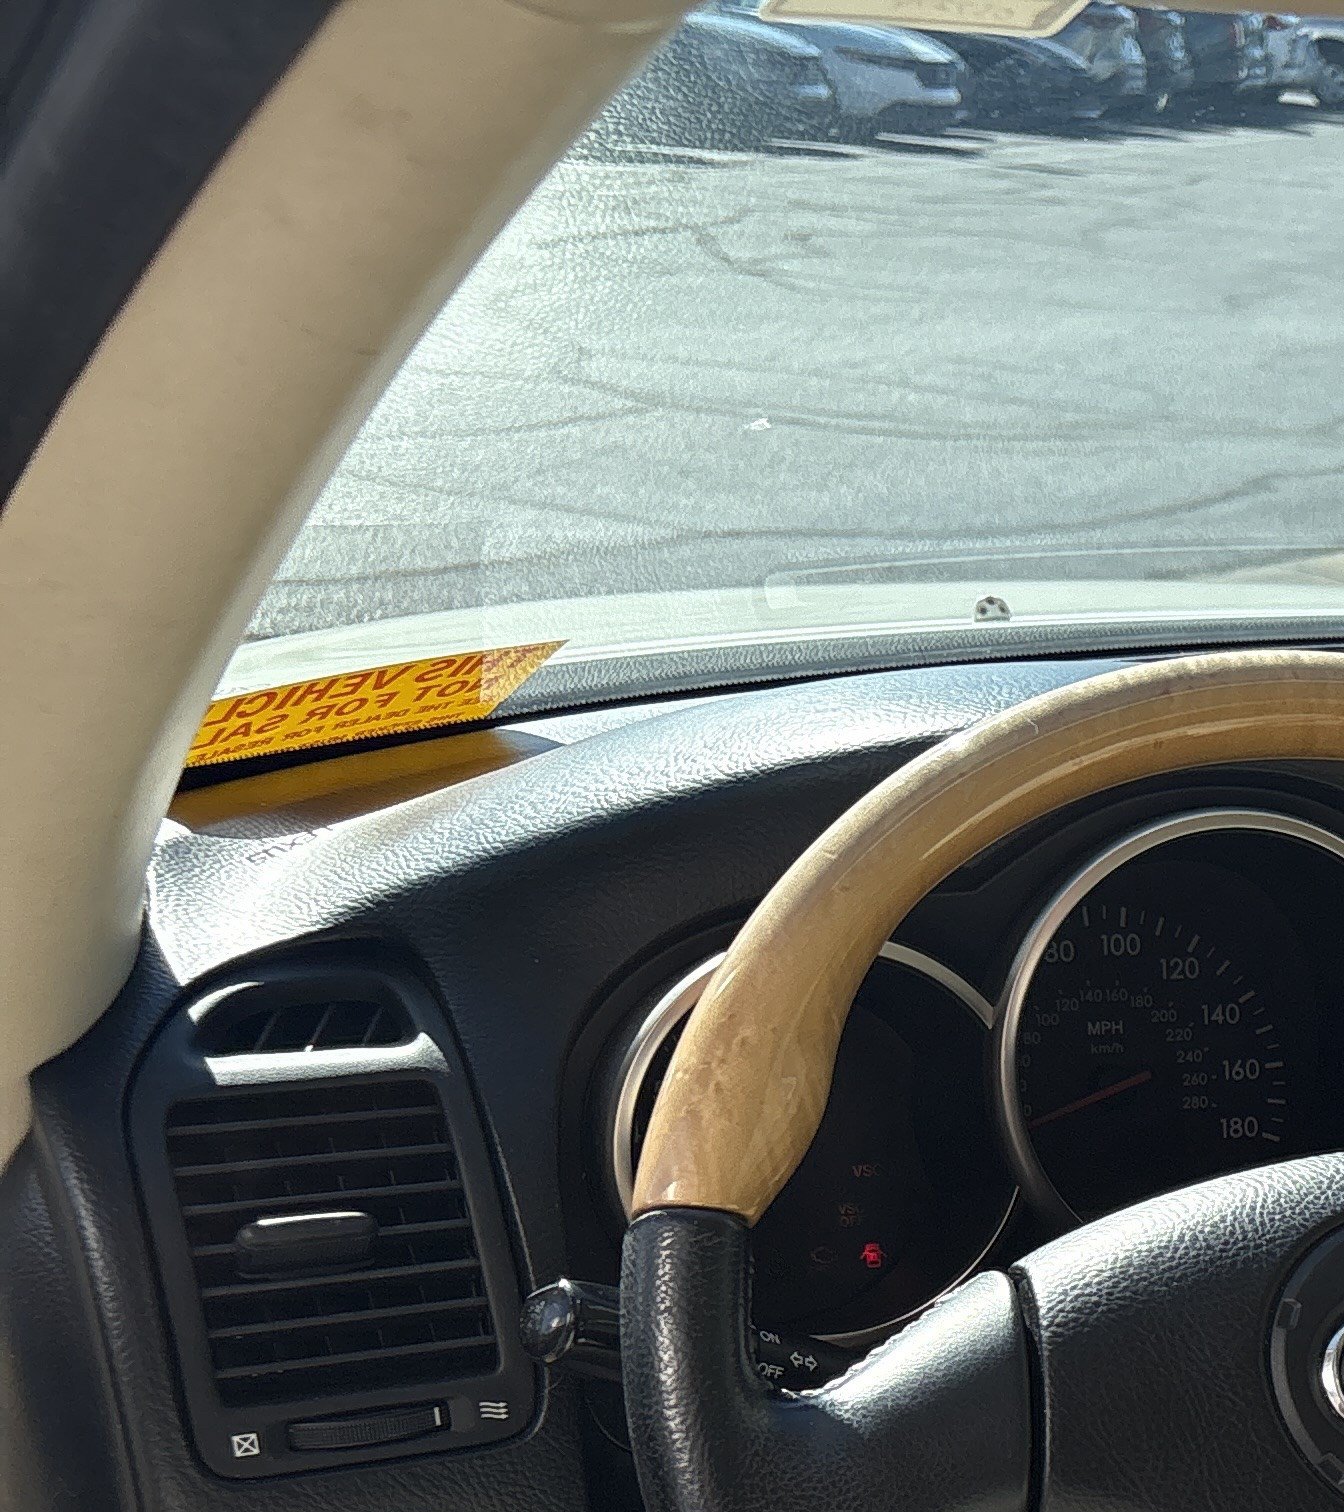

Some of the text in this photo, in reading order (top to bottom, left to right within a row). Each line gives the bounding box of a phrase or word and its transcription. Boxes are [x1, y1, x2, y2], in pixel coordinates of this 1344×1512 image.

[1044, 940, 1075, 963] 80
[1100, 933, 1142, 956] 100
[1160, 957, 1199, 980] 120
[1079, 989, 1103, 1002] 140
[1105, 988, 1129, 1002] 160
[1130, 994, 1153, 1008] 180
[1056, 998, 1079, 1012] 120
[1036, 1013, 1060, 1026] 100
[1150, 1009, 1177, 1023] 200
[1201, 1003, 1241, 1025] 140
[1087, 1020, 1124, 1037] MPH
[1165, 1028, 1193, 1042] 220
[1090, 1042, 1125, 1054] km/h
[1176, 1049, 1203, 1063] 240
[1222, 1058, 1261, 1081] 160
[1182, 1072, 1208, 1086] 260
[1182, 1095, 1209, 1109] 280
[1220, 1116, 1259, 1139] 180
[759, 1330, 781, 1345] ON
[757, 1362, 785, 1379] OFF
